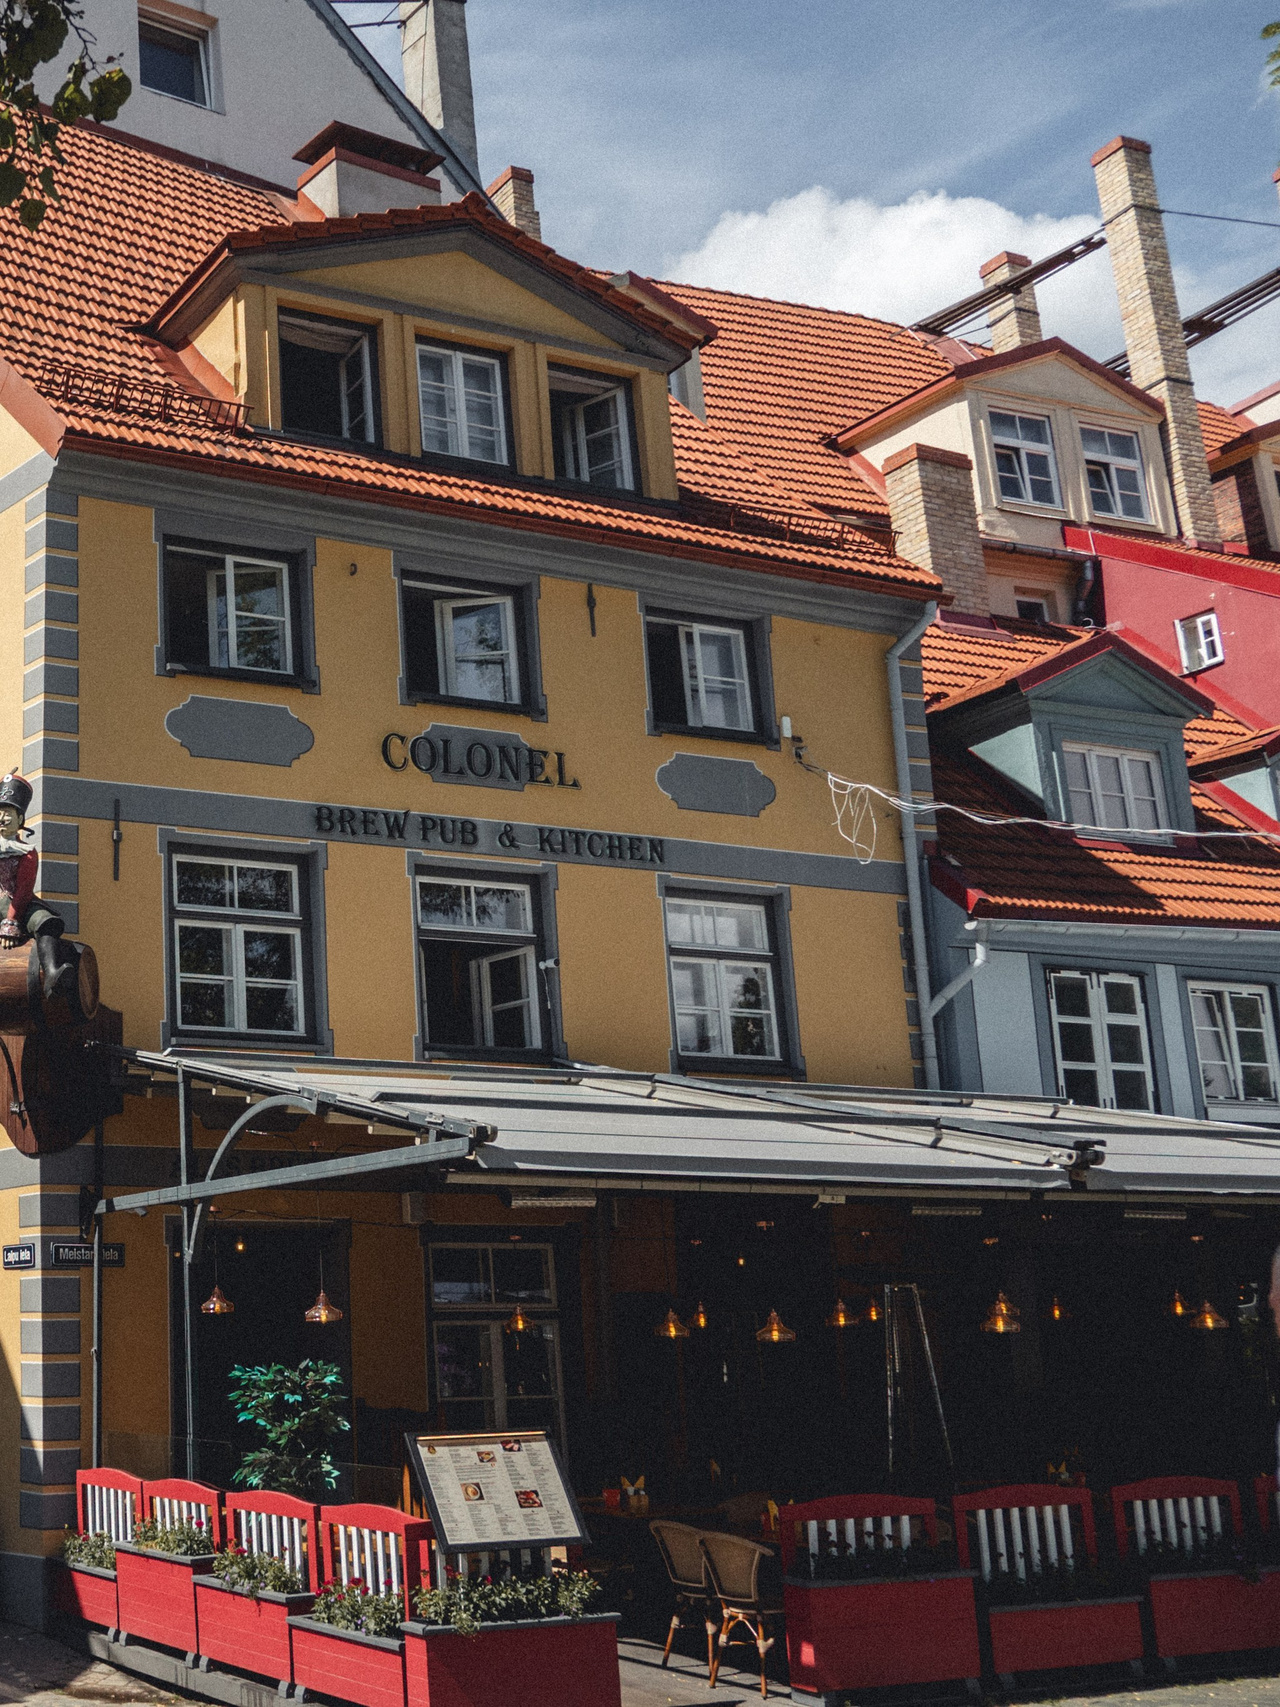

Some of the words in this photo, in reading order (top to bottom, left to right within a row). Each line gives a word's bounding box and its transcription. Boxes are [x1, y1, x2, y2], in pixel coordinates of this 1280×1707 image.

[381, 732, 582, 790] COLONEL
[315, 806, 411, 840] BREW
[419, 816, 479, 846] PUB
[497, 824, 520, 848] &
[537, 827, 666, 864] KITCHEN
[4, 1250, 19, 1264] Laipu
[20, 1248, 31, 1261] iela
[59, 1247, 96, 1260] Meistar
